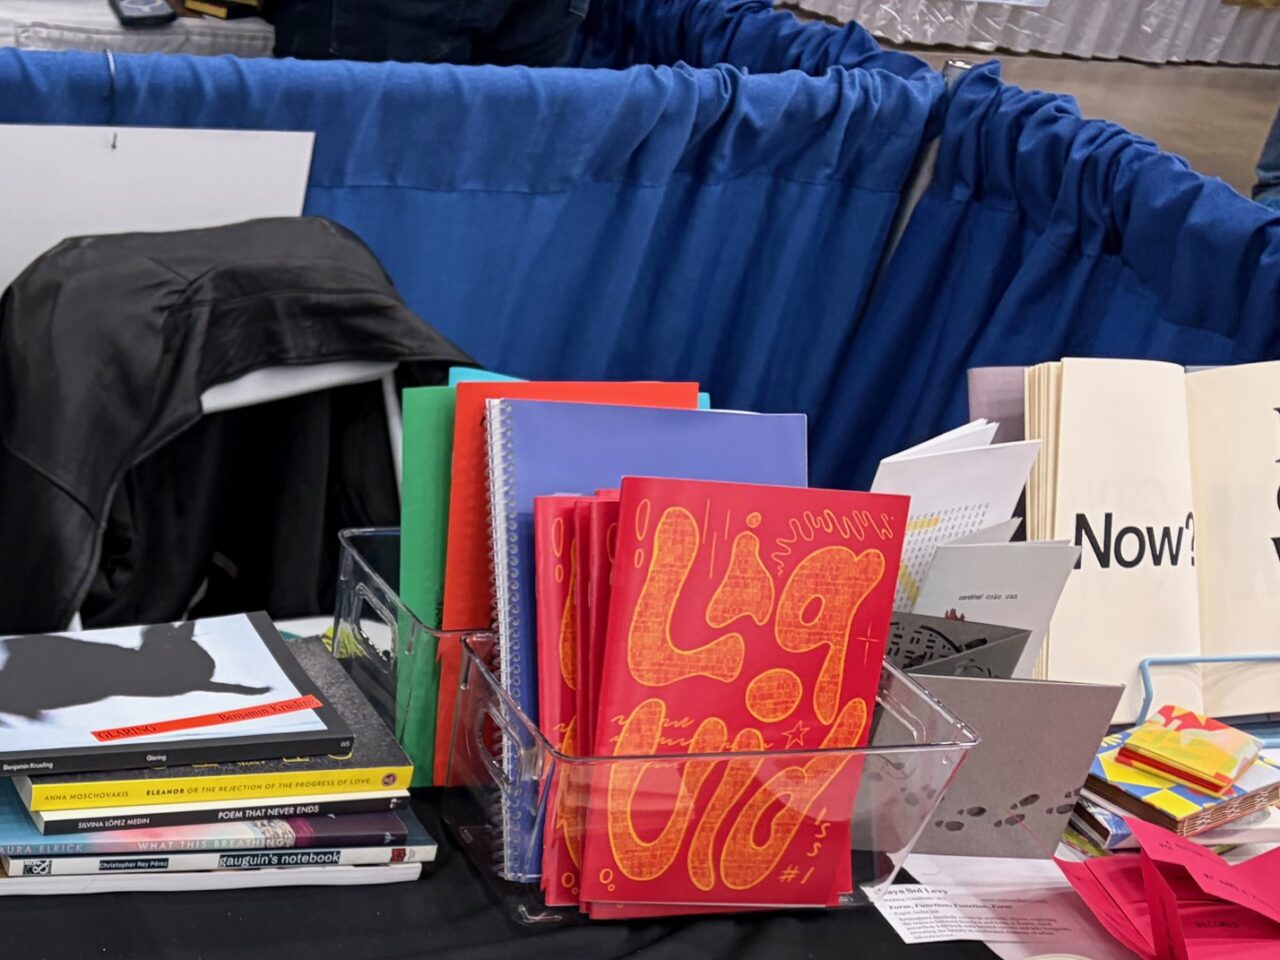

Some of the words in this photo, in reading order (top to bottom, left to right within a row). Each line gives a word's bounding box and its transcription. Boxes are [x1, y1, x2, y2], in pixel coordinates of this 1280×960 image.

[97, 725, 157, 741] GLARING
[219, 706, 270, 722] Benjamin
[3, 763, 29, 771] Benjamin
[30, 761, 53, 770] Krusling
[146, 754, 167, 762] Glaring
[70, 791, 129, 801] MOSCHOVAKIS
[146, 788, 185, 796] ELEANOR
[295, 780, 335, 788] PROGRESS
[218, 810, 243, 819] POEM
[245, 809, 266, 818] THAT
[267, 807, 295, 816] NEVER
[296, 805, 319, 814] ENDS
[78, 821, 104, 829] SILVINA
[105, 818, 126, 827] LÓPEZ
[127, 817, 150, 825] MEDIN
[39, 843, 83, 853] ELRICK
[137, 841, 170, 850] WHAT
[180, 839, 208, 848] THIS
[213, 838, 285, 849] BREATHING
[100, 861, 135, 870] Christopher
[220, 854, 278, 867] gauguin's
[281, 852, 340, 865] notebook
